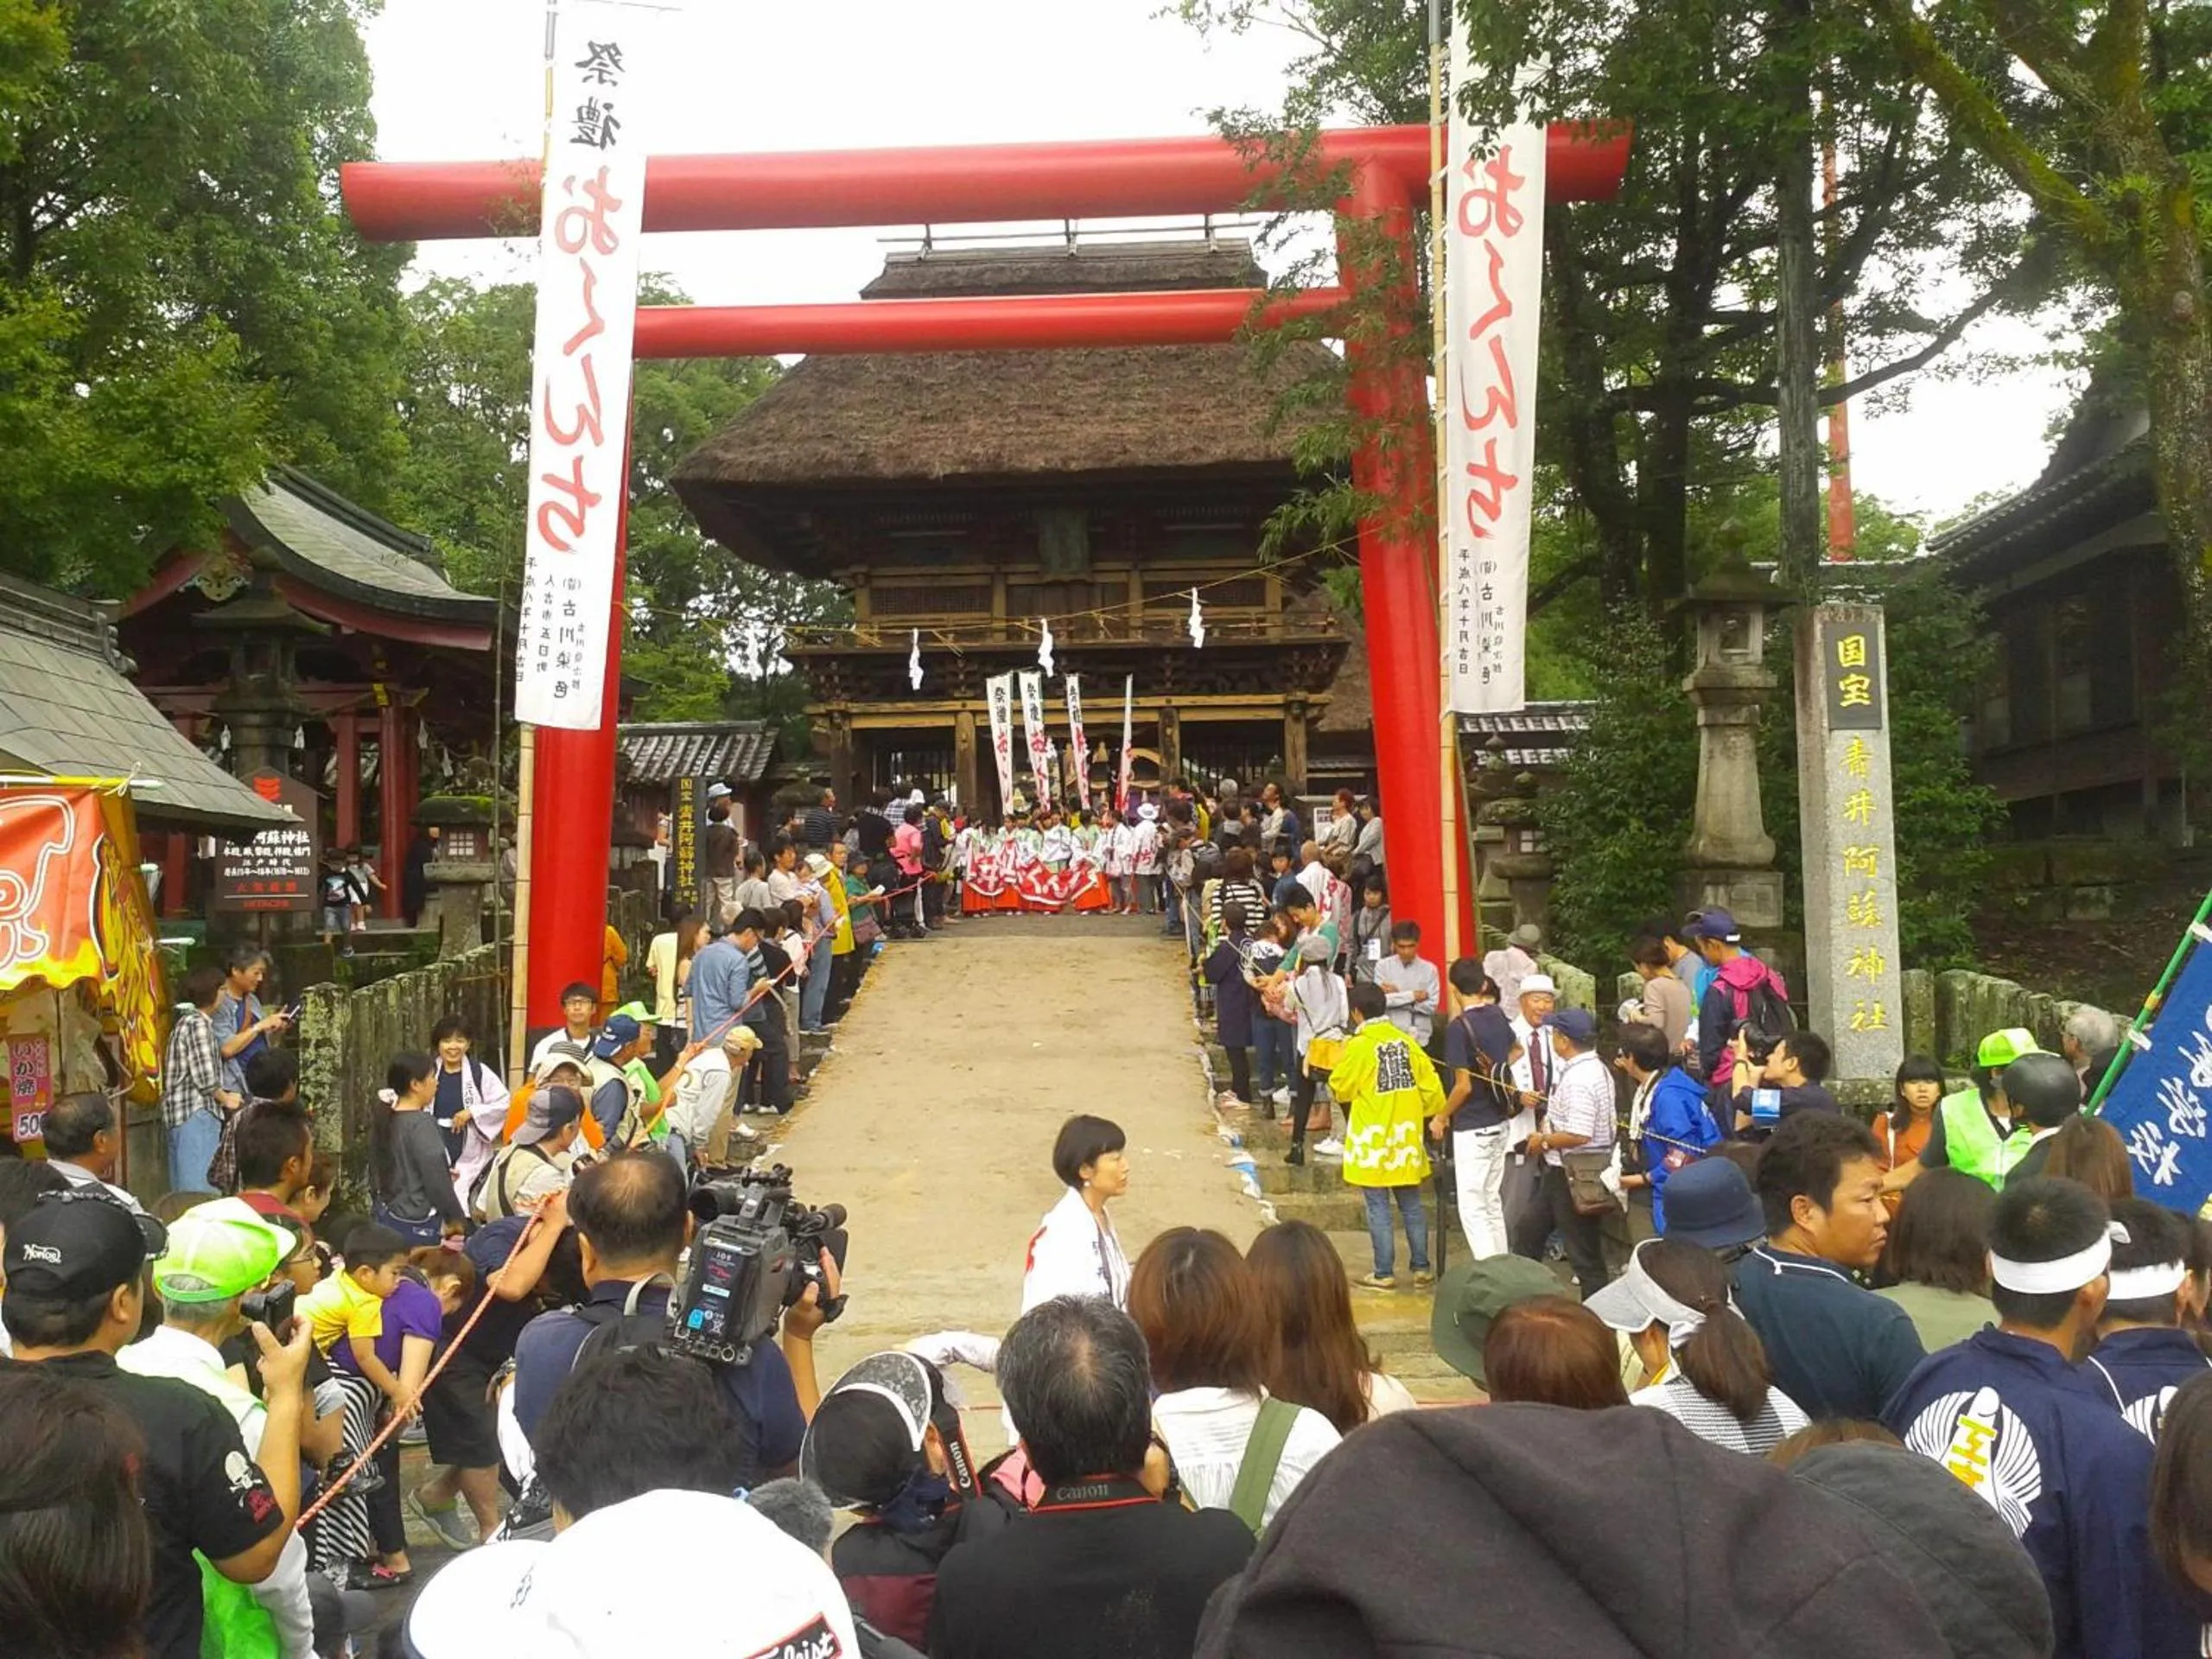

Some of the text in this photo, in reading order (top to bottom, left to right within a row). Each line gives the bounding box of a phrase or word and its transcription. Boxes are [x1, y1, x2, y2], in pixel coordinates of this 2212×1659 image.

[1836, 634, 1872, 709] 国宝
[950, 1440, 971, 1489] Canon
[1056, 1484, 1109, 1501] Canon
